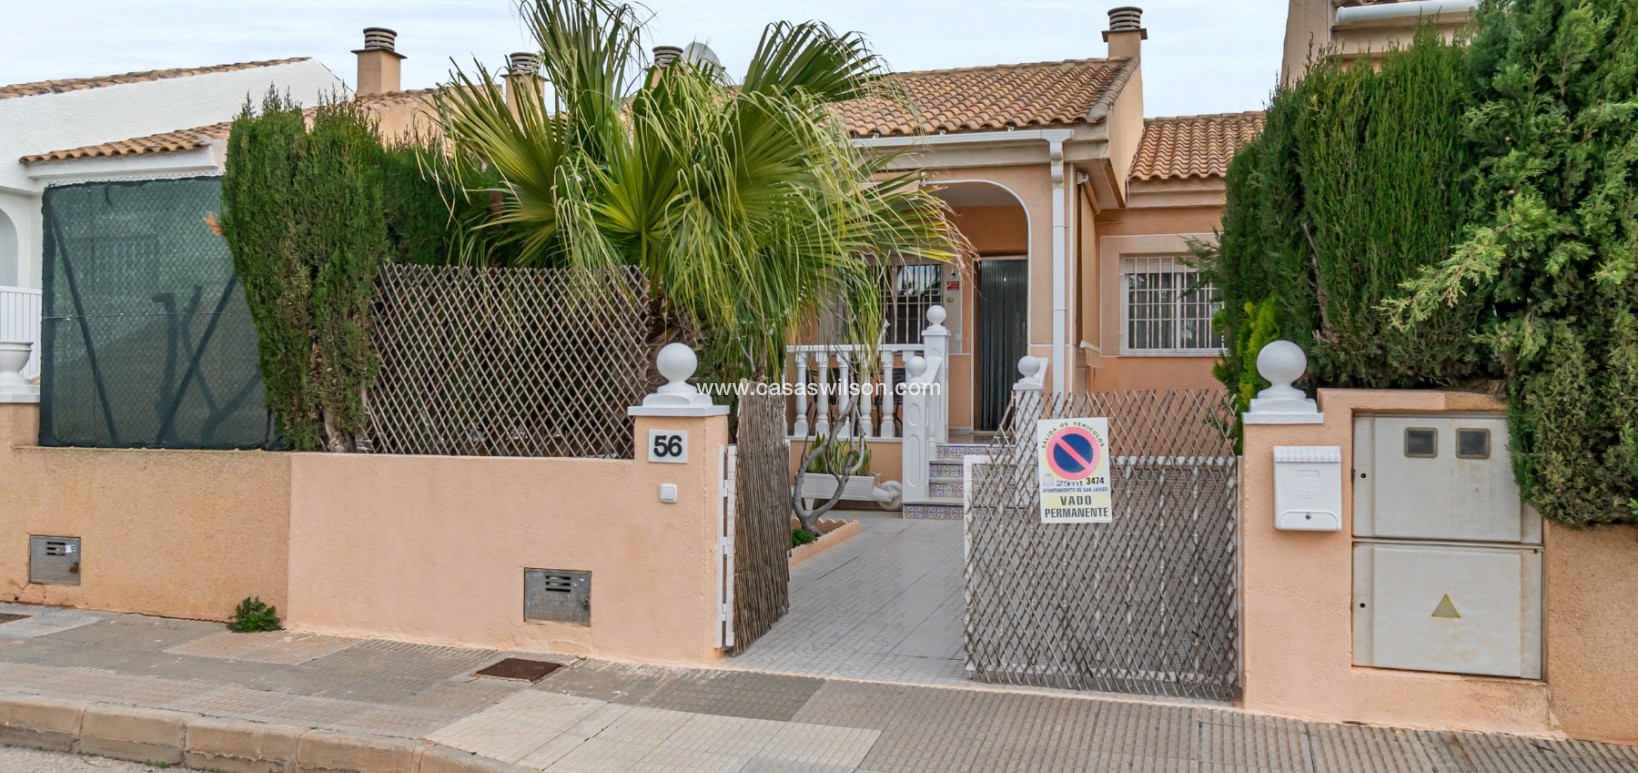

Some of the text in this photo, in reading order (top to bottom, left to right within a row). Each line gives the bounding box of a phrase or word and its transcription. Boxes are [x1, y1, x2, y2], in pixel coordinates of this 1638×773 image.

[1042, 427, 1057, 448] SALIDA
[653, 434, 682, 457] 56
[1086, 477, 1104, 485] 3474
[1060, 495, 1092, 505] VADO
[1044, 507, 1109, 518] PERMANENTE
